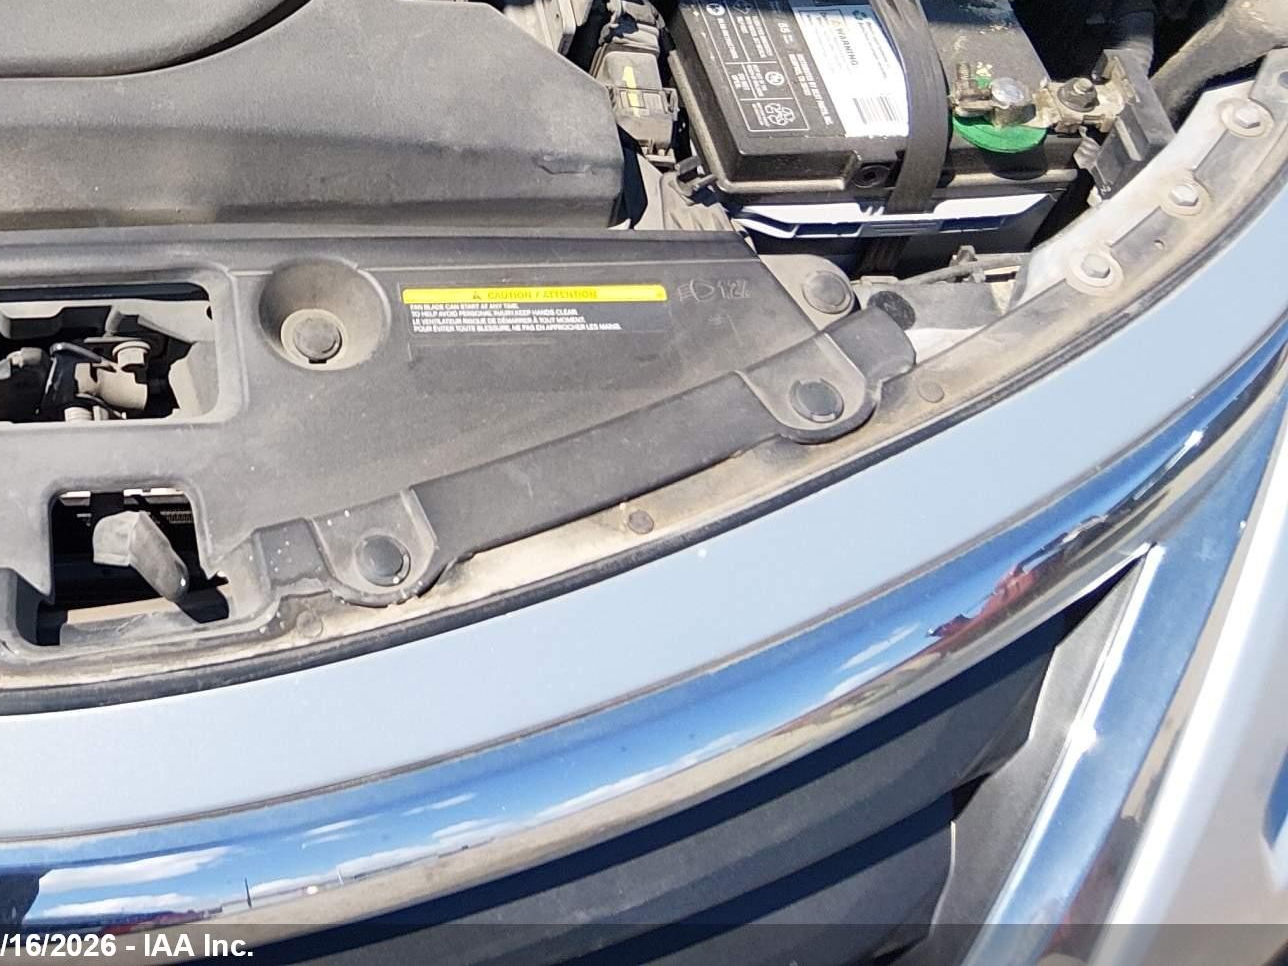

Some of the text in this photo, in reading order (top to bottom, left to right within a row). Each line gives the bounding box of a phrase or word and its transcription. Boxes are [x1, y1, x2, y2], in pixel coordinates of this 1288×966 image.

[836, 28, 858, 66] WARNING
[488, 291, 532, 299] CAUTION
[543, 289, 598, 299] ATTENTION
